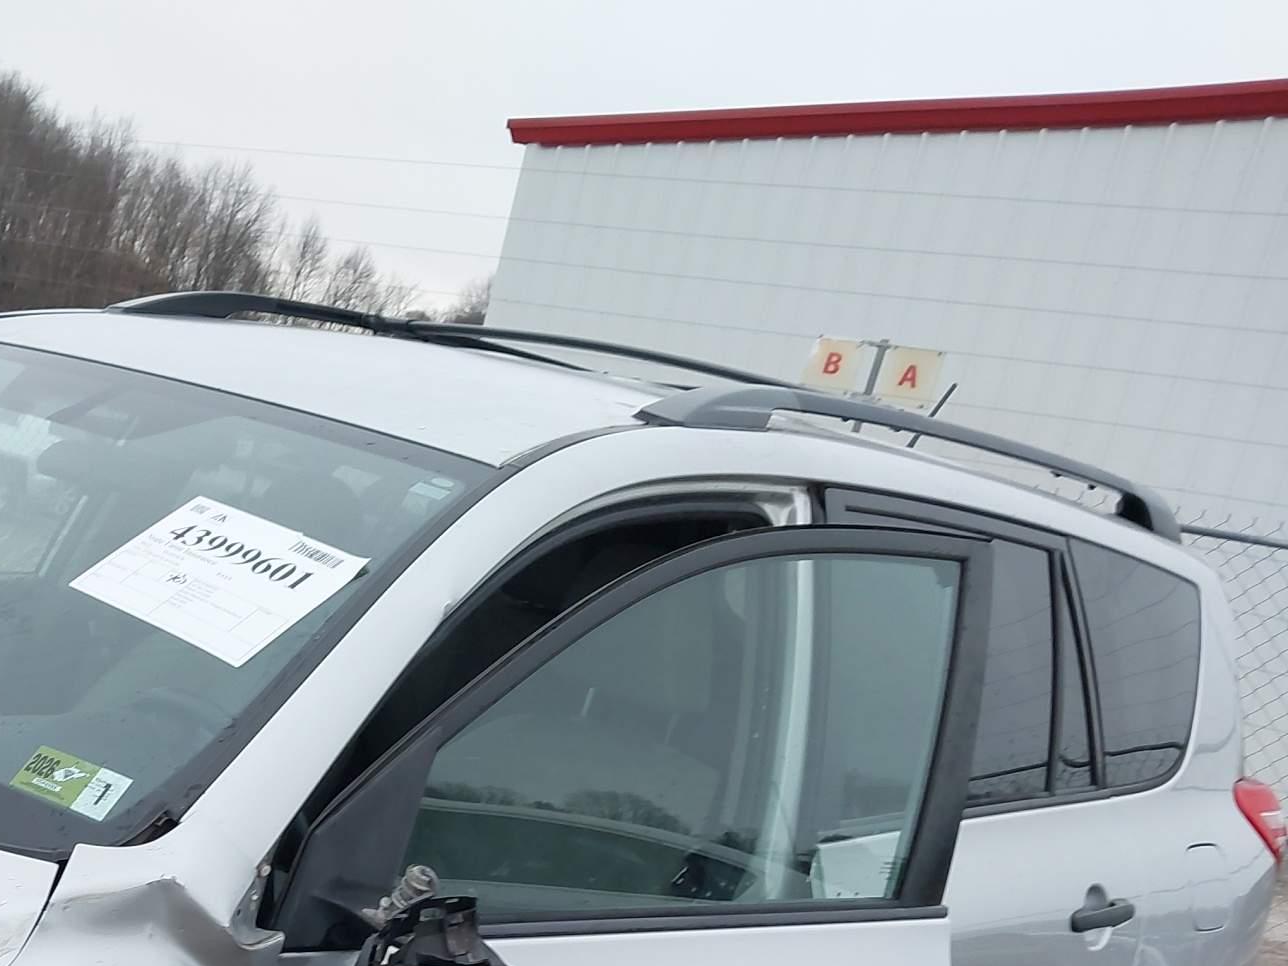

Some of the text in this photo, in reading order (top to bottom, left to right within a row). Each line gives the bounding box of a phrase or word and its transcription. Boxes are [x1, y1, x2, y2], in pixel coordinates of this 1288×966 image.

[822, 351, 843, 375] B
[897, 363, 919, 389] A
[168, 524, 316, 590] 43999601
[23, 753, 61, 779] 2026
